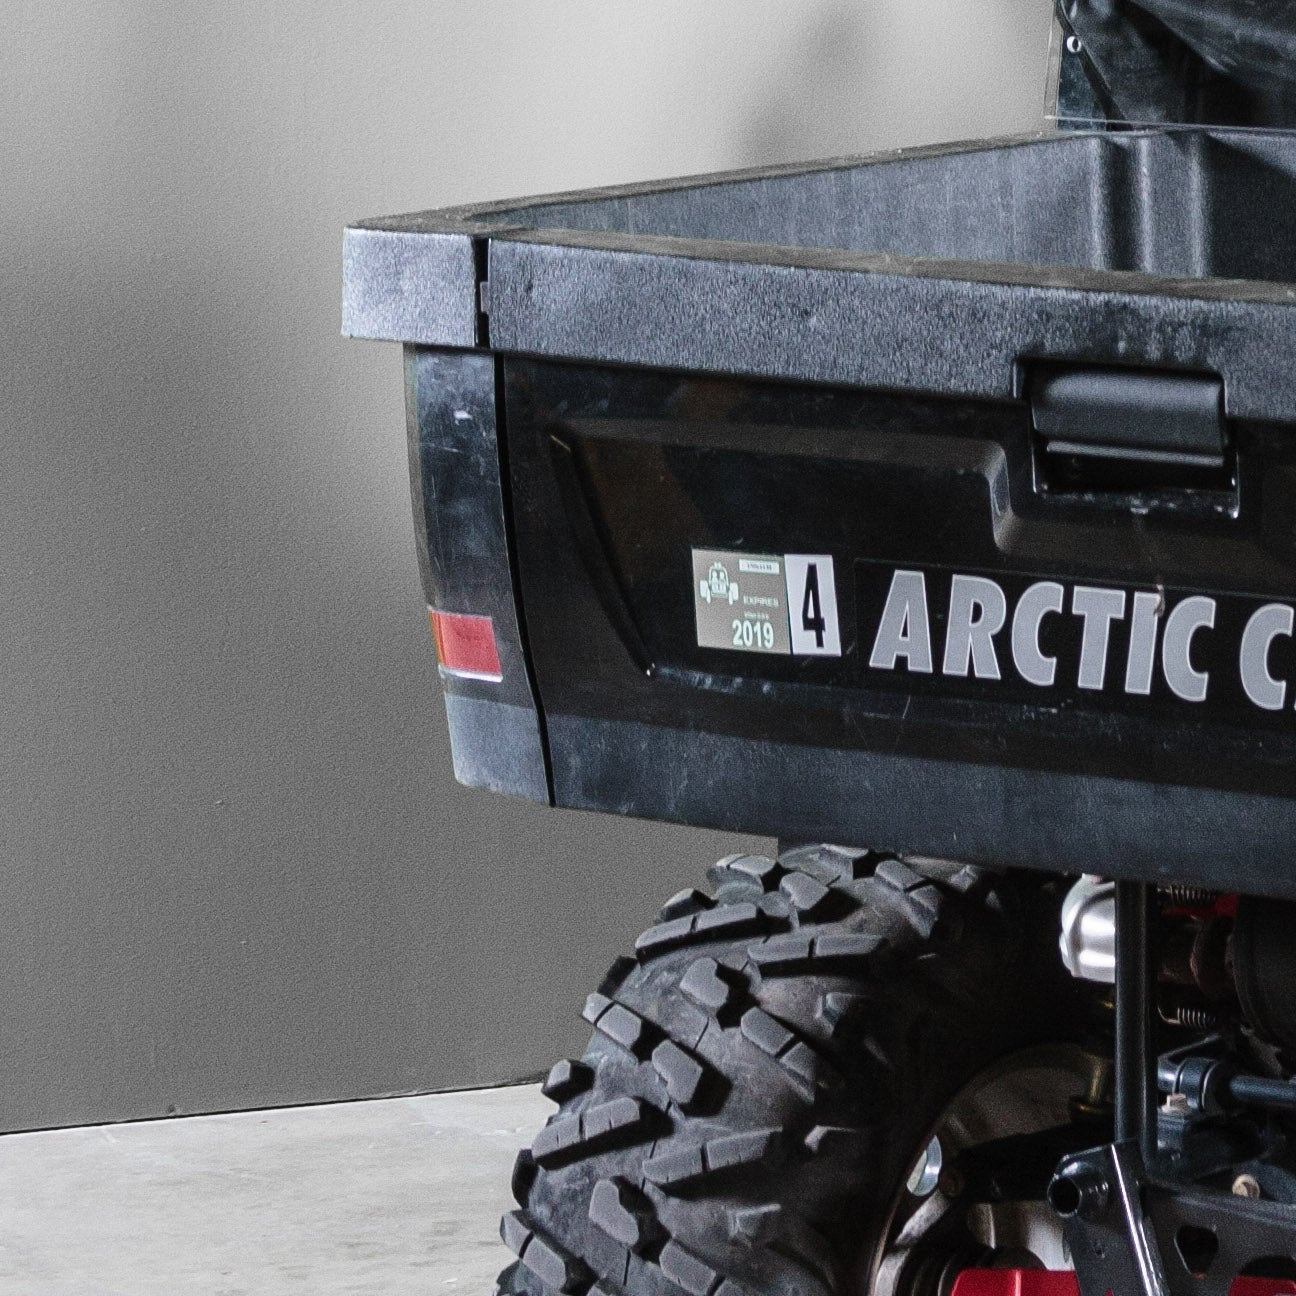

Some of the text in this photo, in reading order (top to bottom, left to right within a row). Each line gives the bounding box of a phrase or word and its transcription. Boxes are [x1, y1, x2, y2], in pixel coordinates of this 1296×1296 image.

[732, 619, 774, 650] 2019
[803, 564, 826, 648] 4
[869, 570, 1216, 702] ARCTIC
